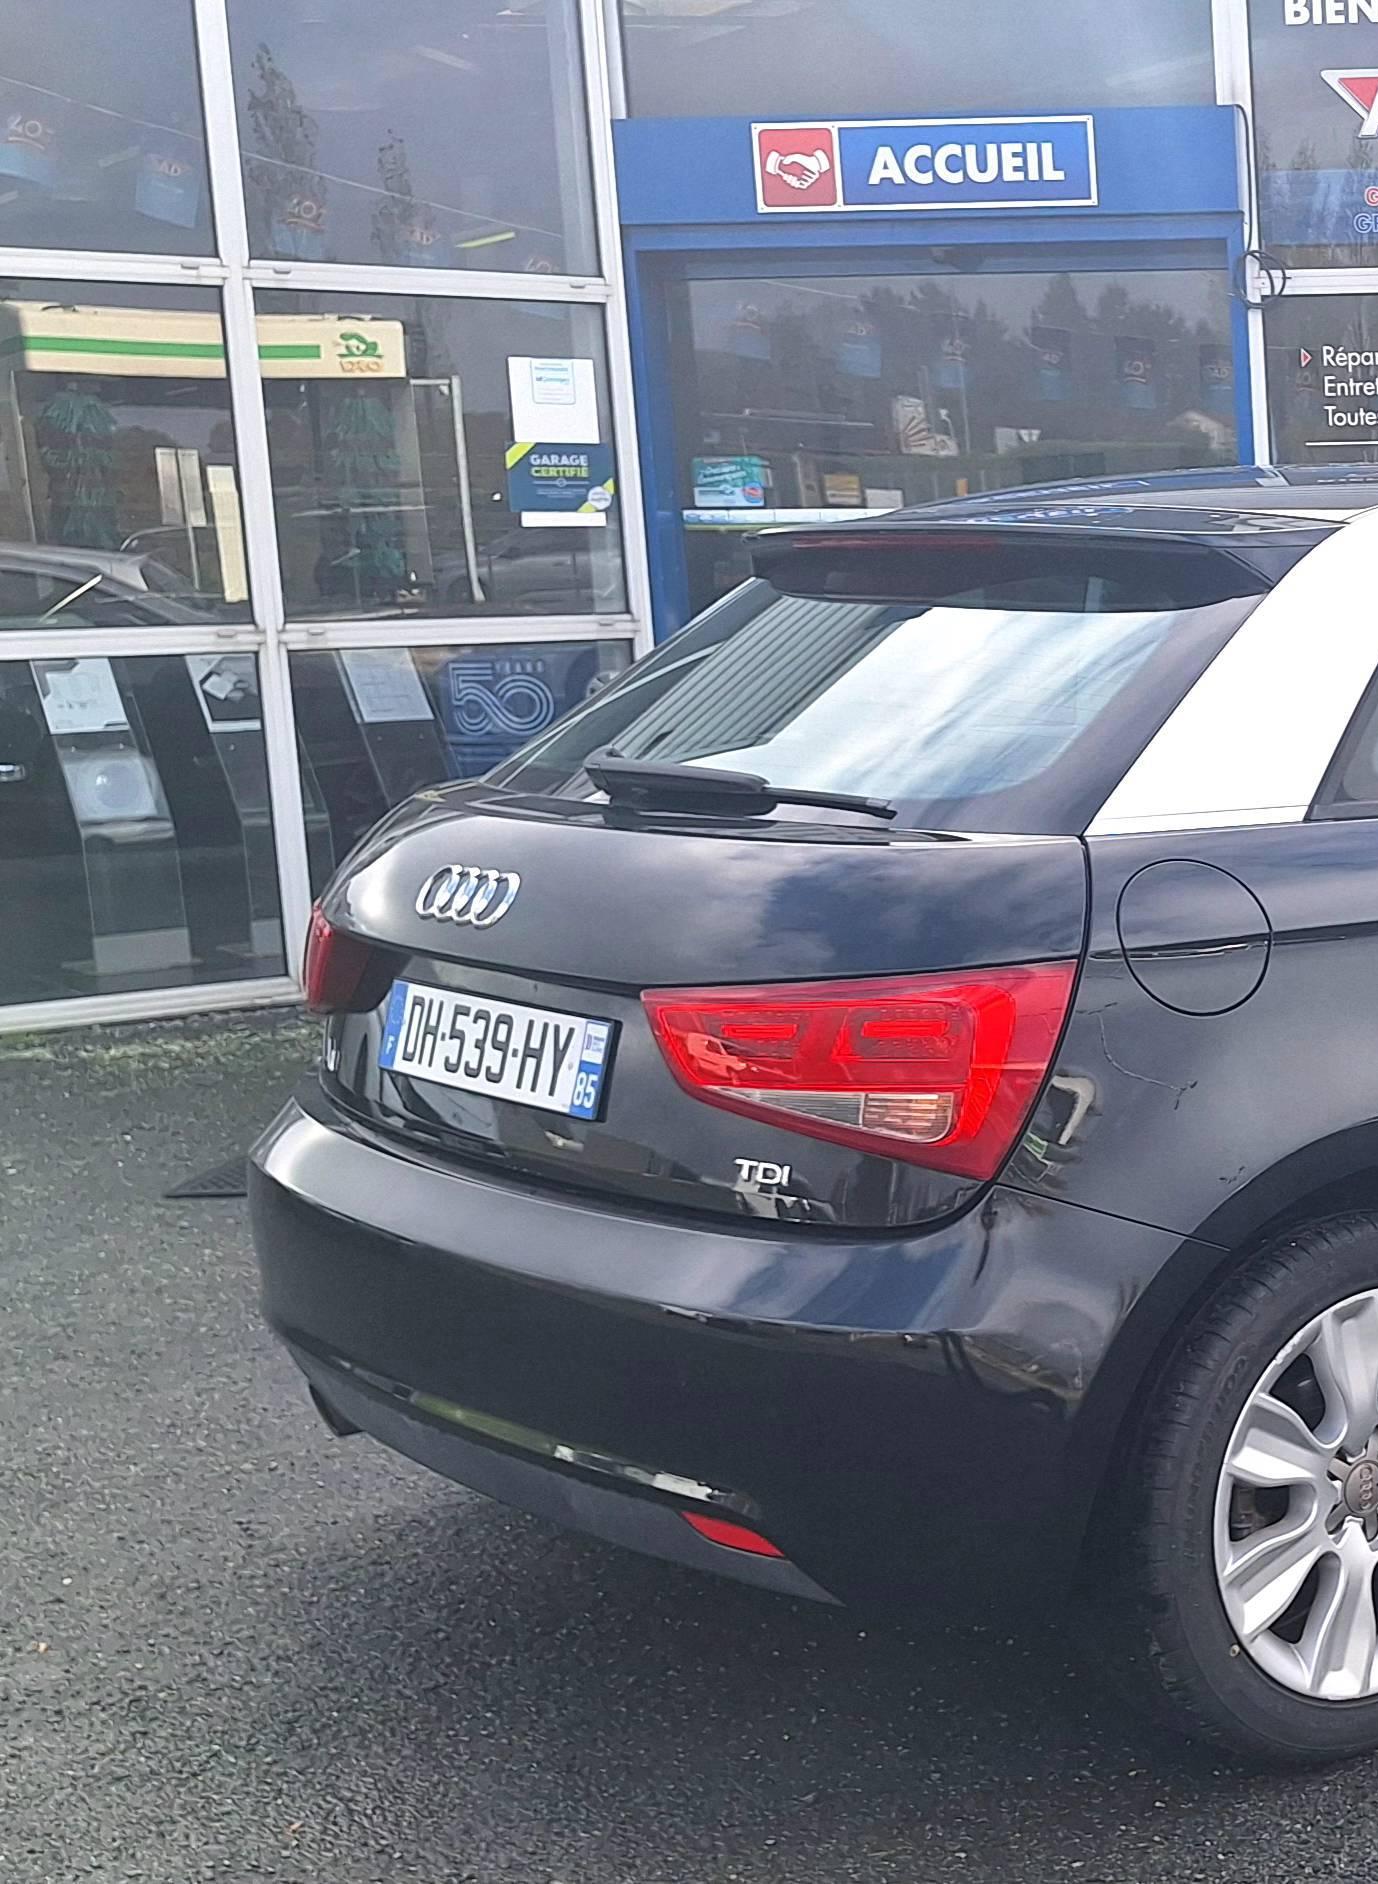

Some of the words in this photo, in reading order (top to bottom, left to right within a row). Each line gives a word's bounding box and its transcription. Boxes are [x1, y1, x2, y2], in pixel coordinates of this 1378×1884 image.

[868, 142, 1065, 185] ACCUEIL
[530, 454, 588, 466] GARAGE
[449, 662, 555, 736] 50
[385, 1035, 395, 1055] F
[573, 1072, 598, 1108] 85
[735, 1158, 790, 1187] TDI
